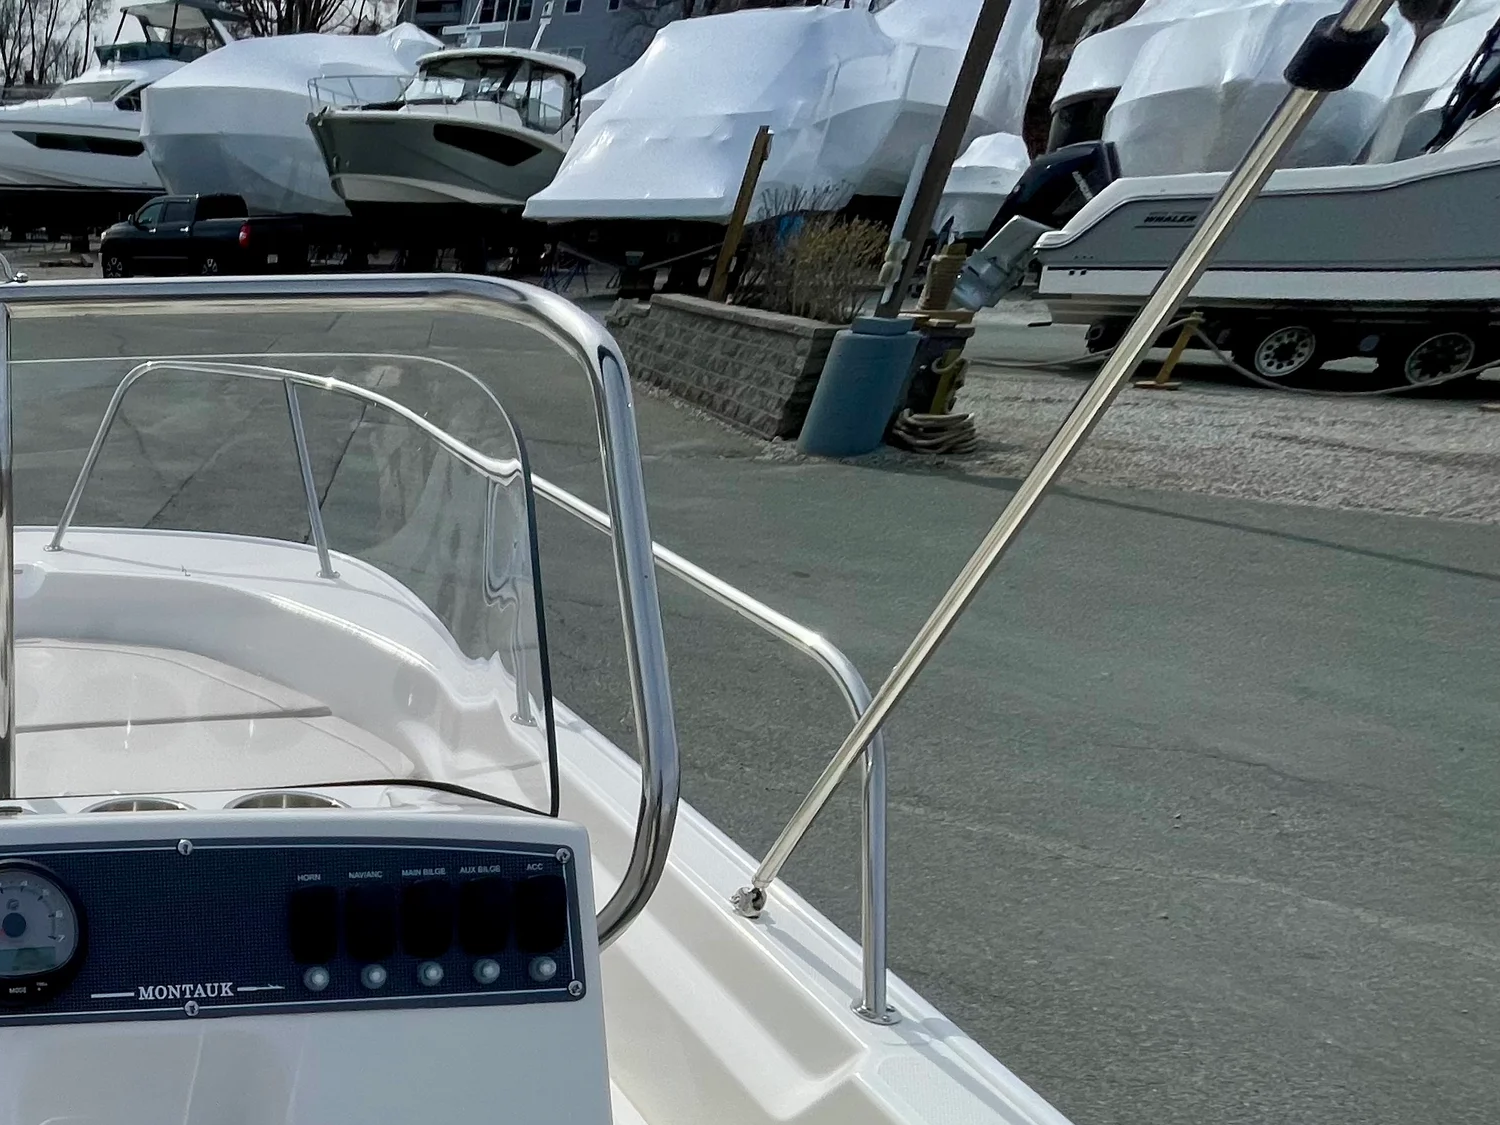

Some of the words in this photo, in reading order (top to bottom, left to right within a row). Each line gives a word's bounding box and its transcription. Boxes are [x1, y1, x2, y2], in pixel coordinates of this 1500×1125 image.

[1143, 214, 1198, 224] WHALER
[460, 866, 476, 874] AUX
[477, 865, 500, 873] BILGE
[526, 863, 543, 871] ACC
[423, 868, 446, 876] BILGE
[297, 874, 321, 882] HORN
[138, 982, 234, 1000] MONTAUK
